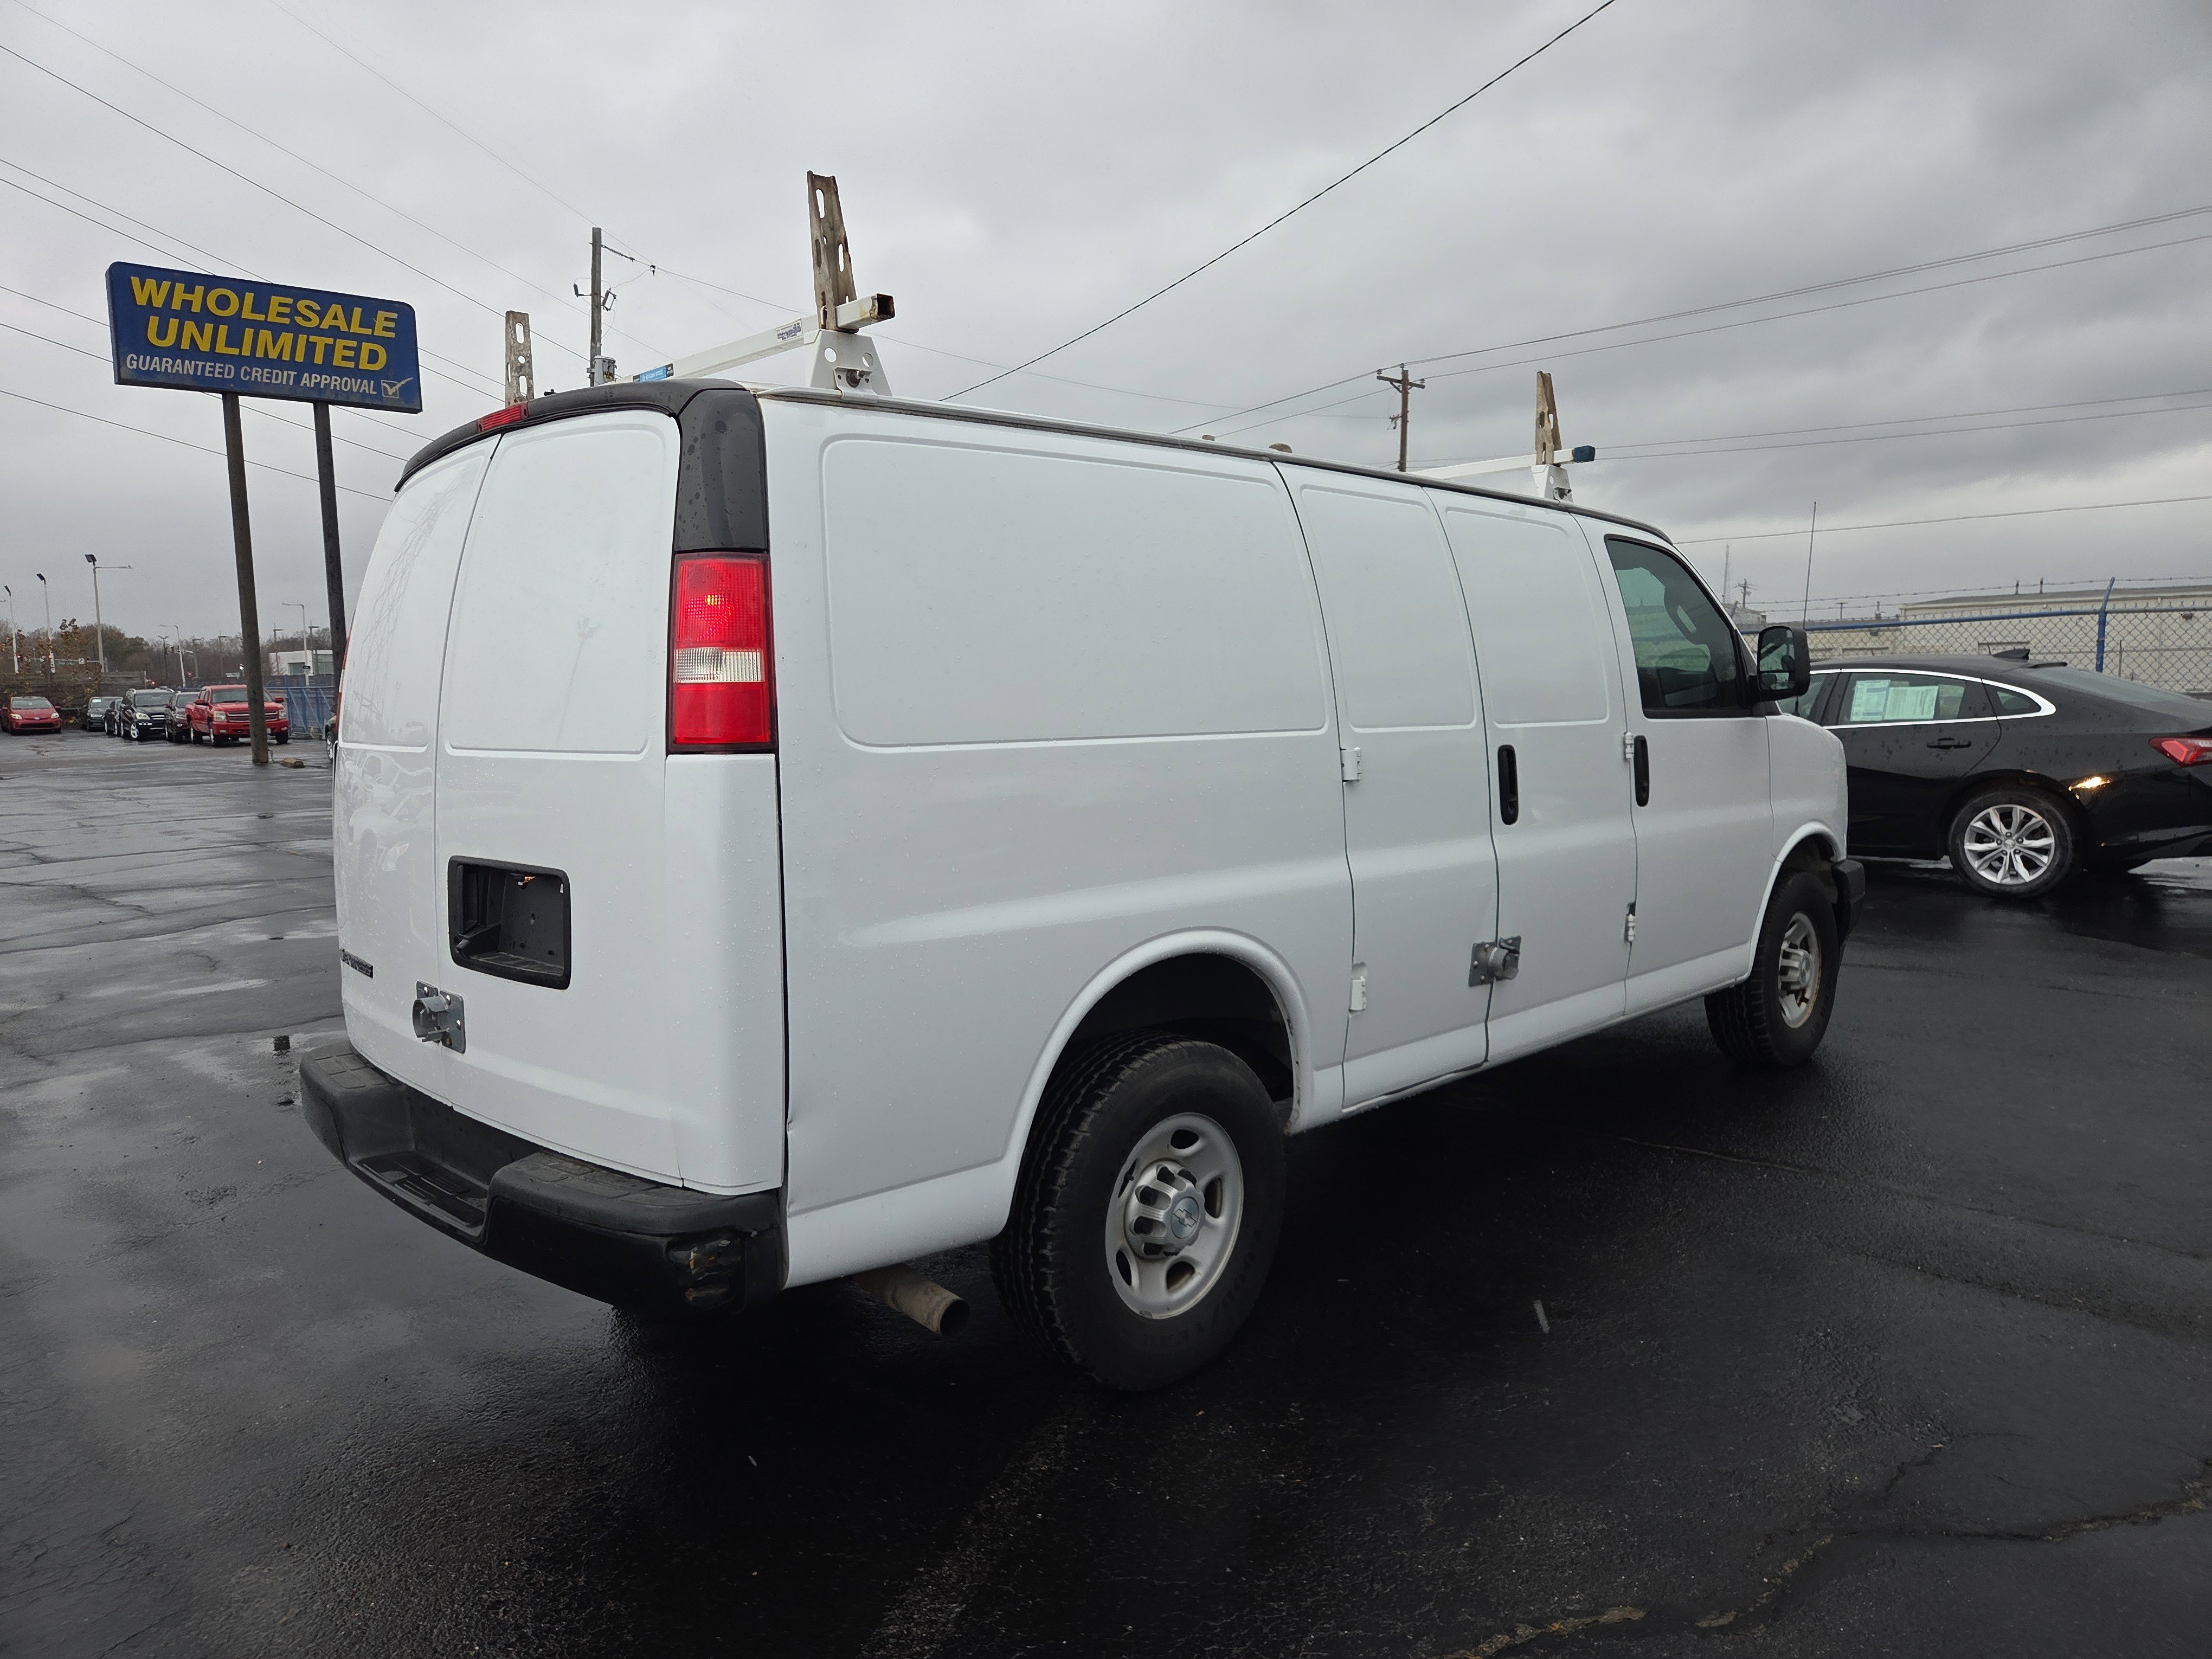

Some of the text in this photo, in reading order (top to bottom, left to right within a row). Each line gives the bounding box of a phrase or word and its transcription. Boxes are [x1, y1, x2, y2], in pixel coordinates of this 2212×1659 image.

[131, 276, 398, 338] WHOLESALE
[147, 316, 387, 371] UNLIMITED
[126, 353, 377, 395] GUARANTEED CREDIT APPROVAL
